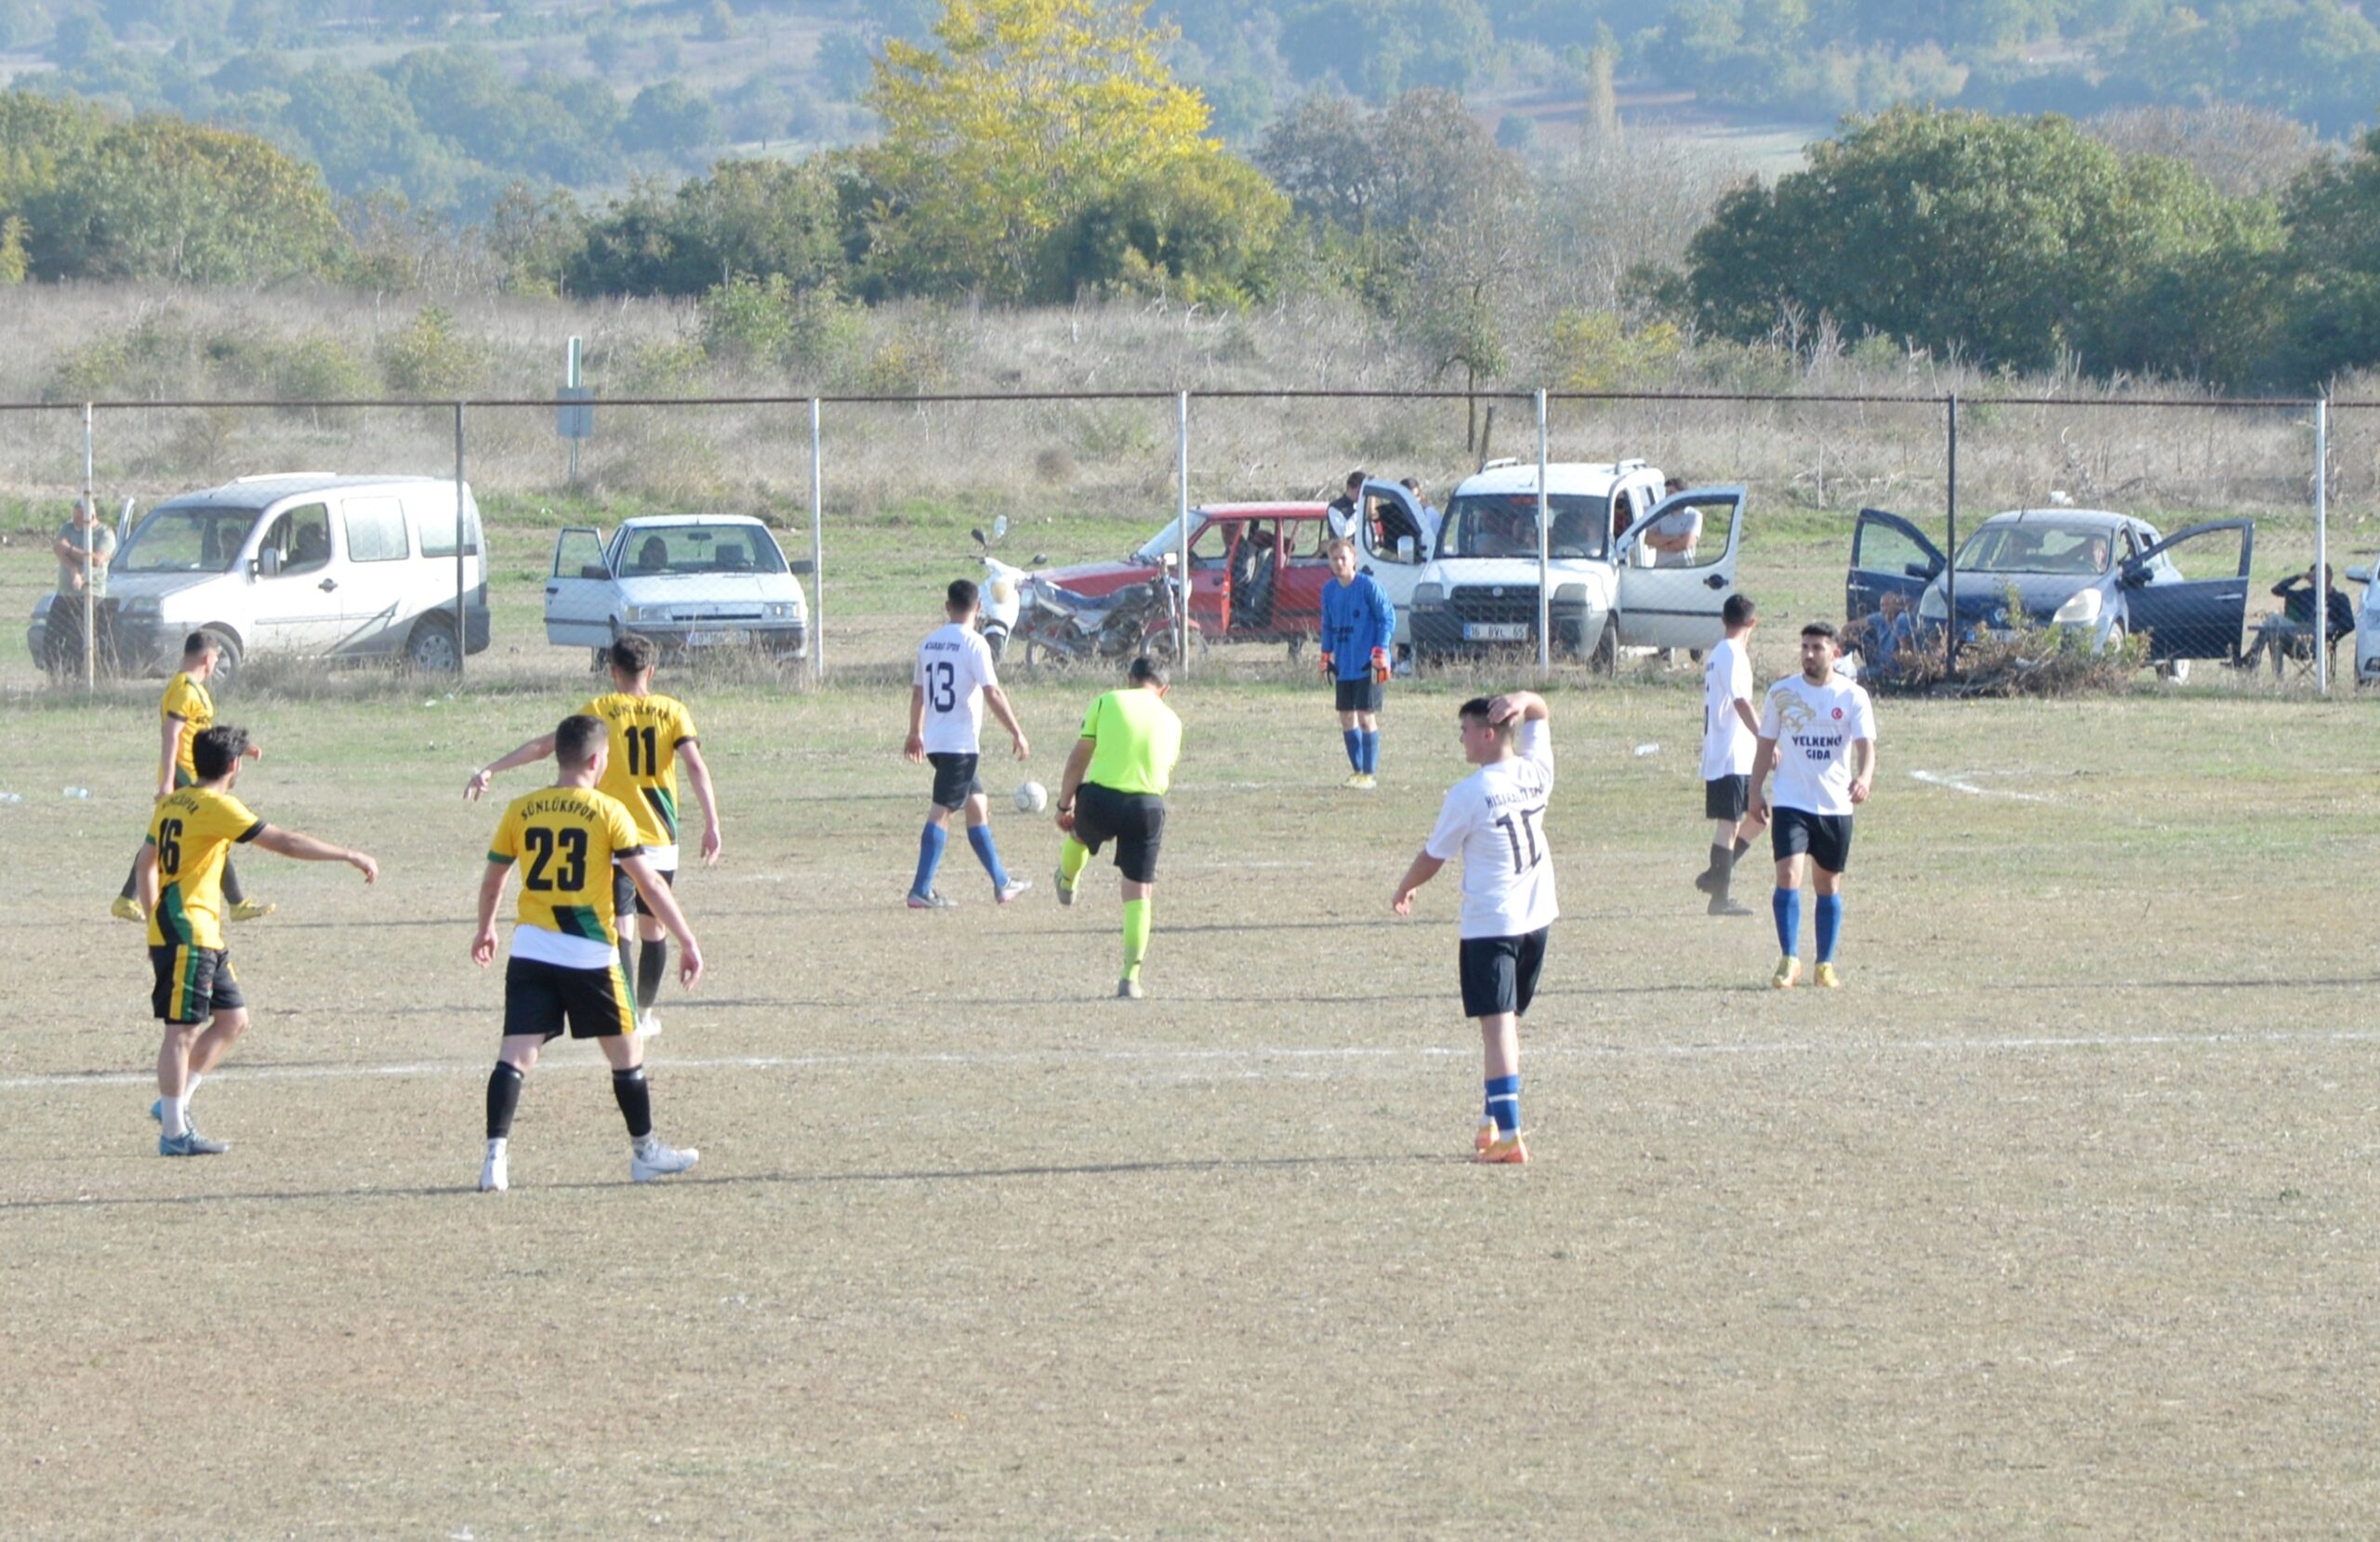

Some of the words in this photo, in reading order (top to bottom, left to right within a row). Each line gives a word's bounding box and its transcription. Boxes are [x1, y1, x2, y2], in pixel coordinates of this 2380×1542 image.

[925, 661, 957, 714] 13
[624, 725, 657, 777] 11
[1805, 748, 1831, 760] GIDA
[521, 796, 597, 824] SÜNLÜKSPOR
[158, 818, 183, 876] 16
[524, 826, 588, 891] 23
